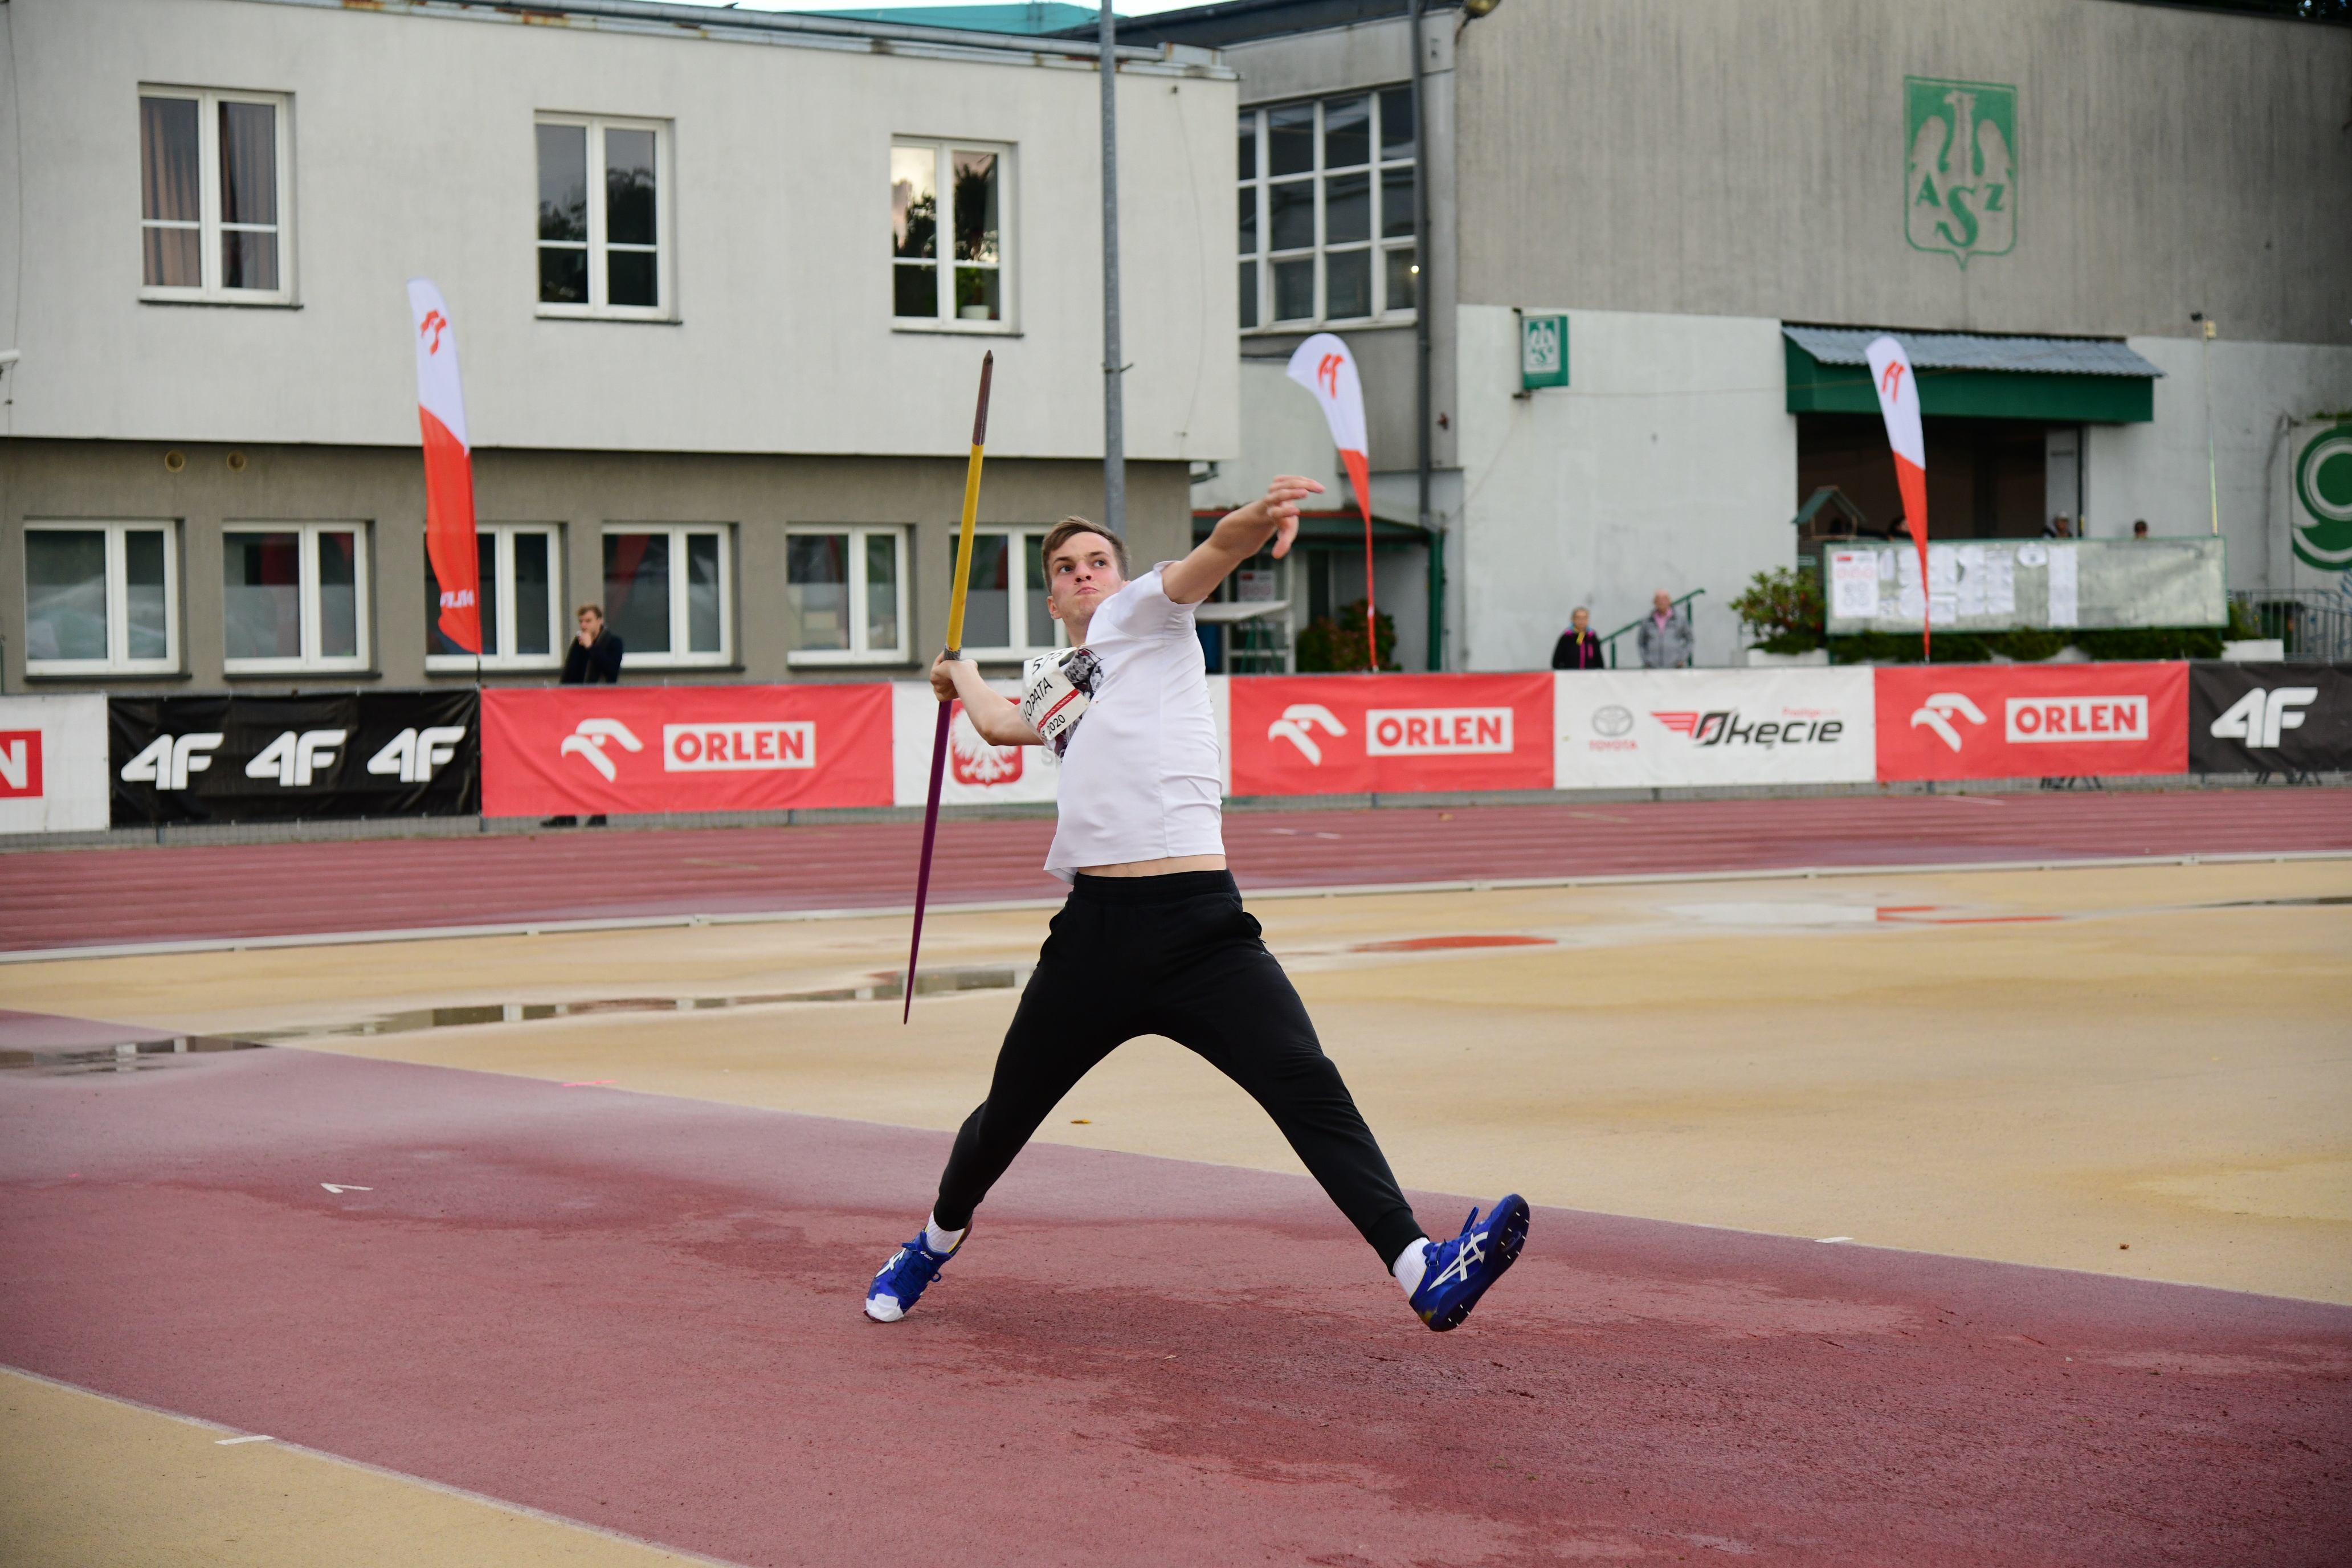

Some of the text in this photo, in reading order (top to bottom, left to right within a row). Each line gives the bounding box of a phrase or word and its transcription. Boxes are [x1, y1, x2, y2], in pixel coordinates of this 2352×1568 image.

[1376, 716, 1502, 748] ORLEN
[2014, 704, 2138, 734] ORLEN
[2210, 687, 2319, 748] 4F
[121, 725, 466, 790] 4F 4F 4F
[672, 730, 804, 762] ORLEN
[1589, 740, 1638, 752] TOYOTA
